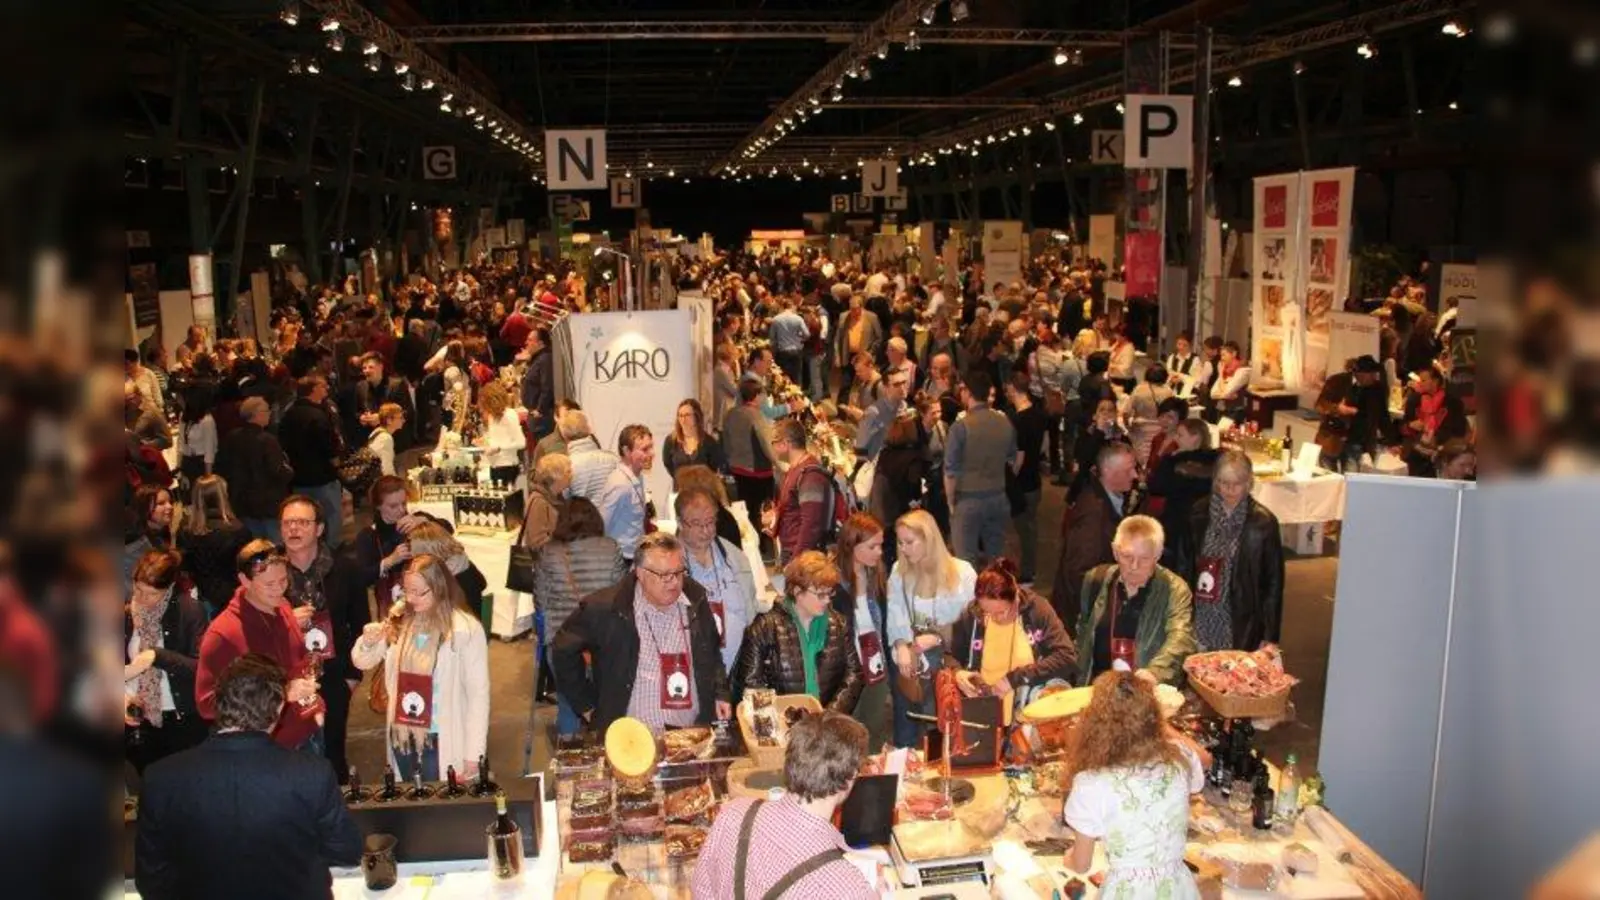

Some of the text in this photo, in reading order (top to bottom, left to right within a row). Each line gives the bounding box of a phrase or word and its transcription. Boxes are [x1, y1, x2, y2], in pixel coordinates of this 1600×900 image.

[1140, 105, 1177, 158] P
[558, 137, 594, 181] N
[1098, 135, 1117, 158] K
[426, 149, 451, 177] G
[872, 166, 886, 192] J
[617, 183, 633, 204] H
[835, 196, 846, 211] B
[856, 194, 870, 210] D
[593, 347, 670, 382] KARO
